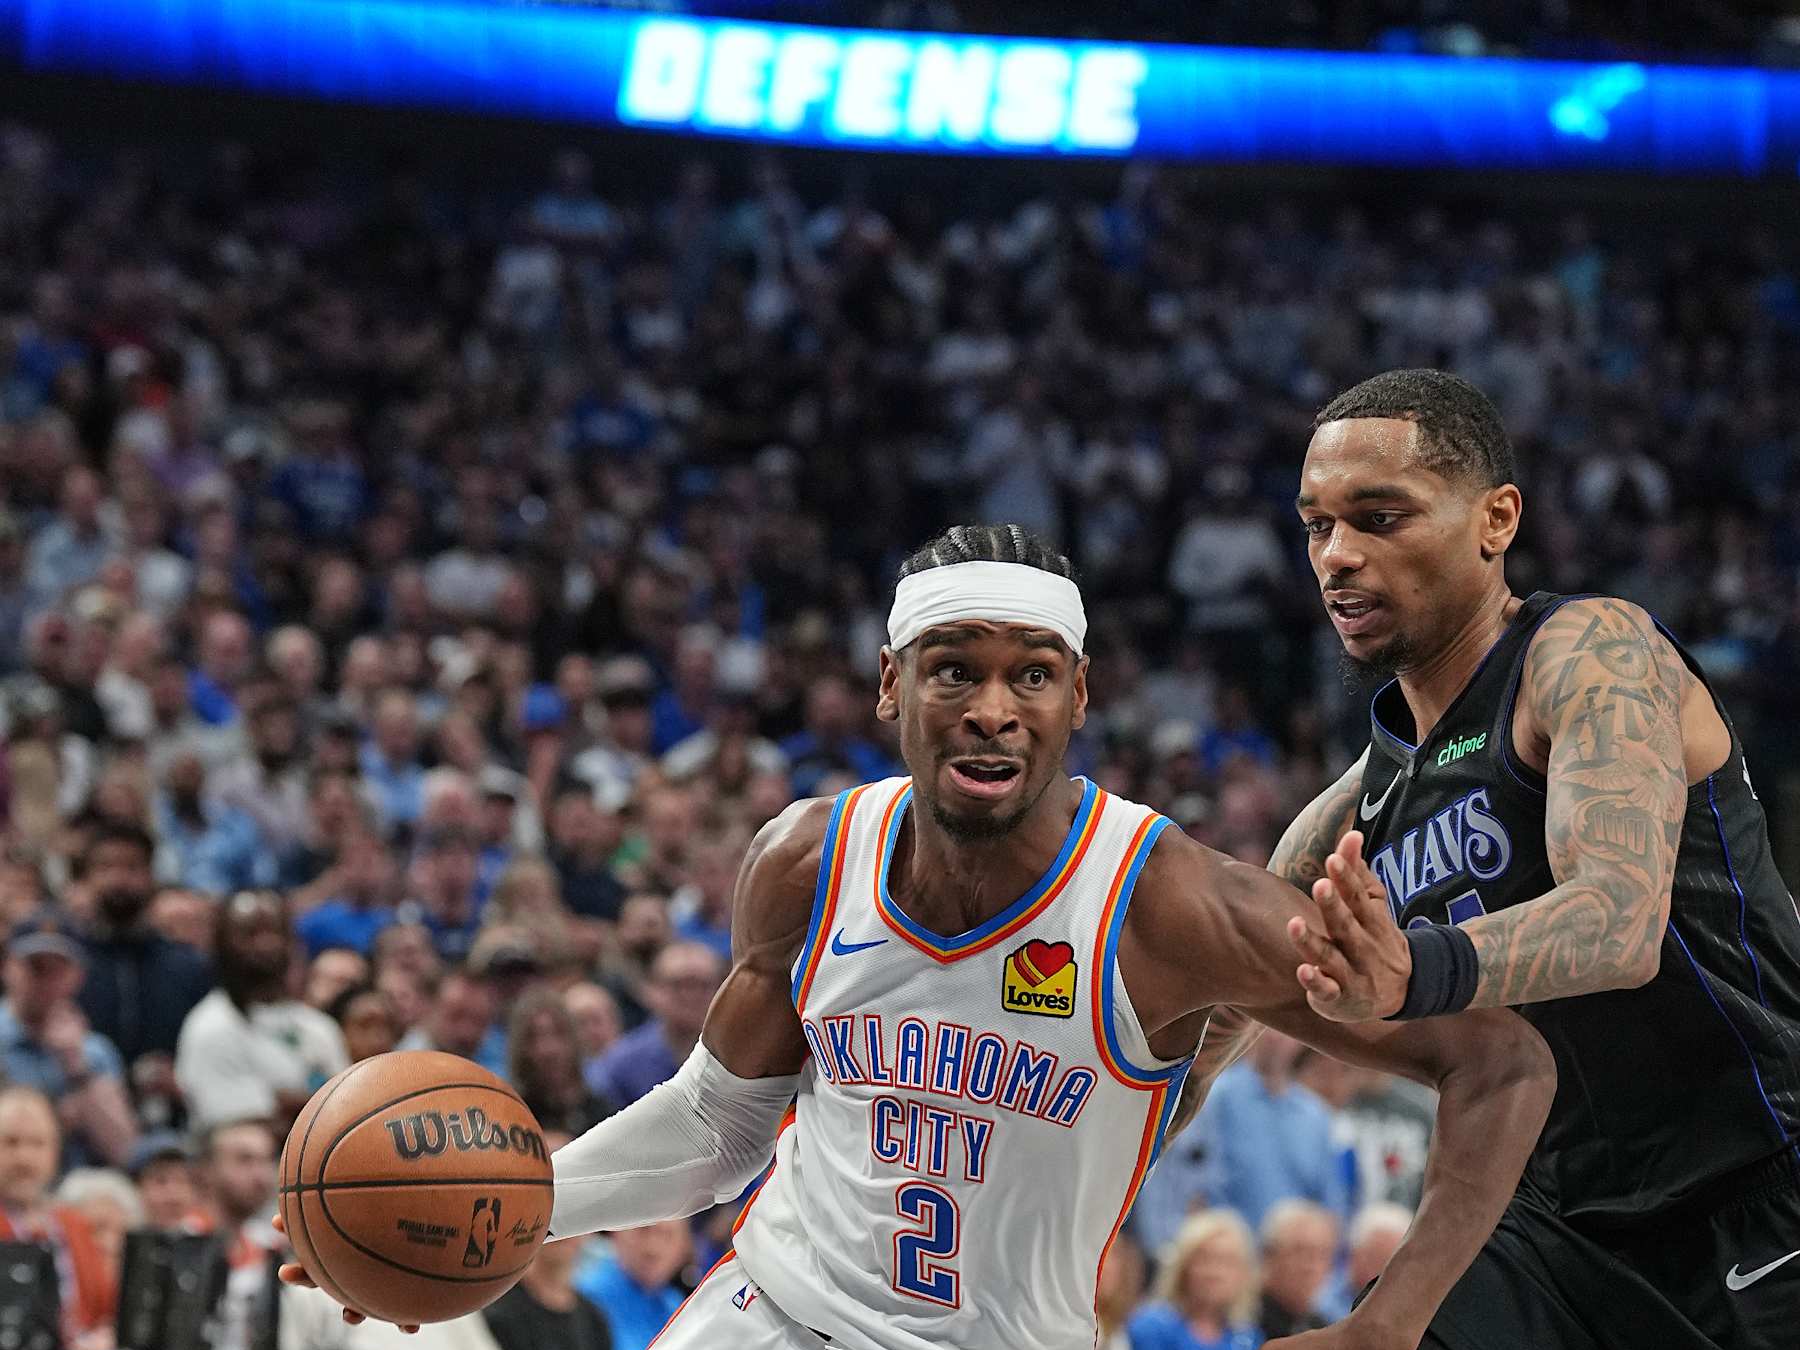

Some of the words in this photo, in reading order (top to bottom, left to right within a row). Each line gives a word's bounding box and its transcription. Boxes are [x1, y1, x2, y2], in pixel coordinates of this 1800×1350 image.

[617, 17, 1147, 151] DEFENSE
[1437, 732, 1487, 767] chime
[1370, 788, 1512, 927] MAVS
[802, 1015, 1098, 1128] OKLAHOMA
[384, 1105, 548, 1166] Wilson
[871, 1095, 995, 1184] CITY
[892, 1180, 961, 1310] 2
